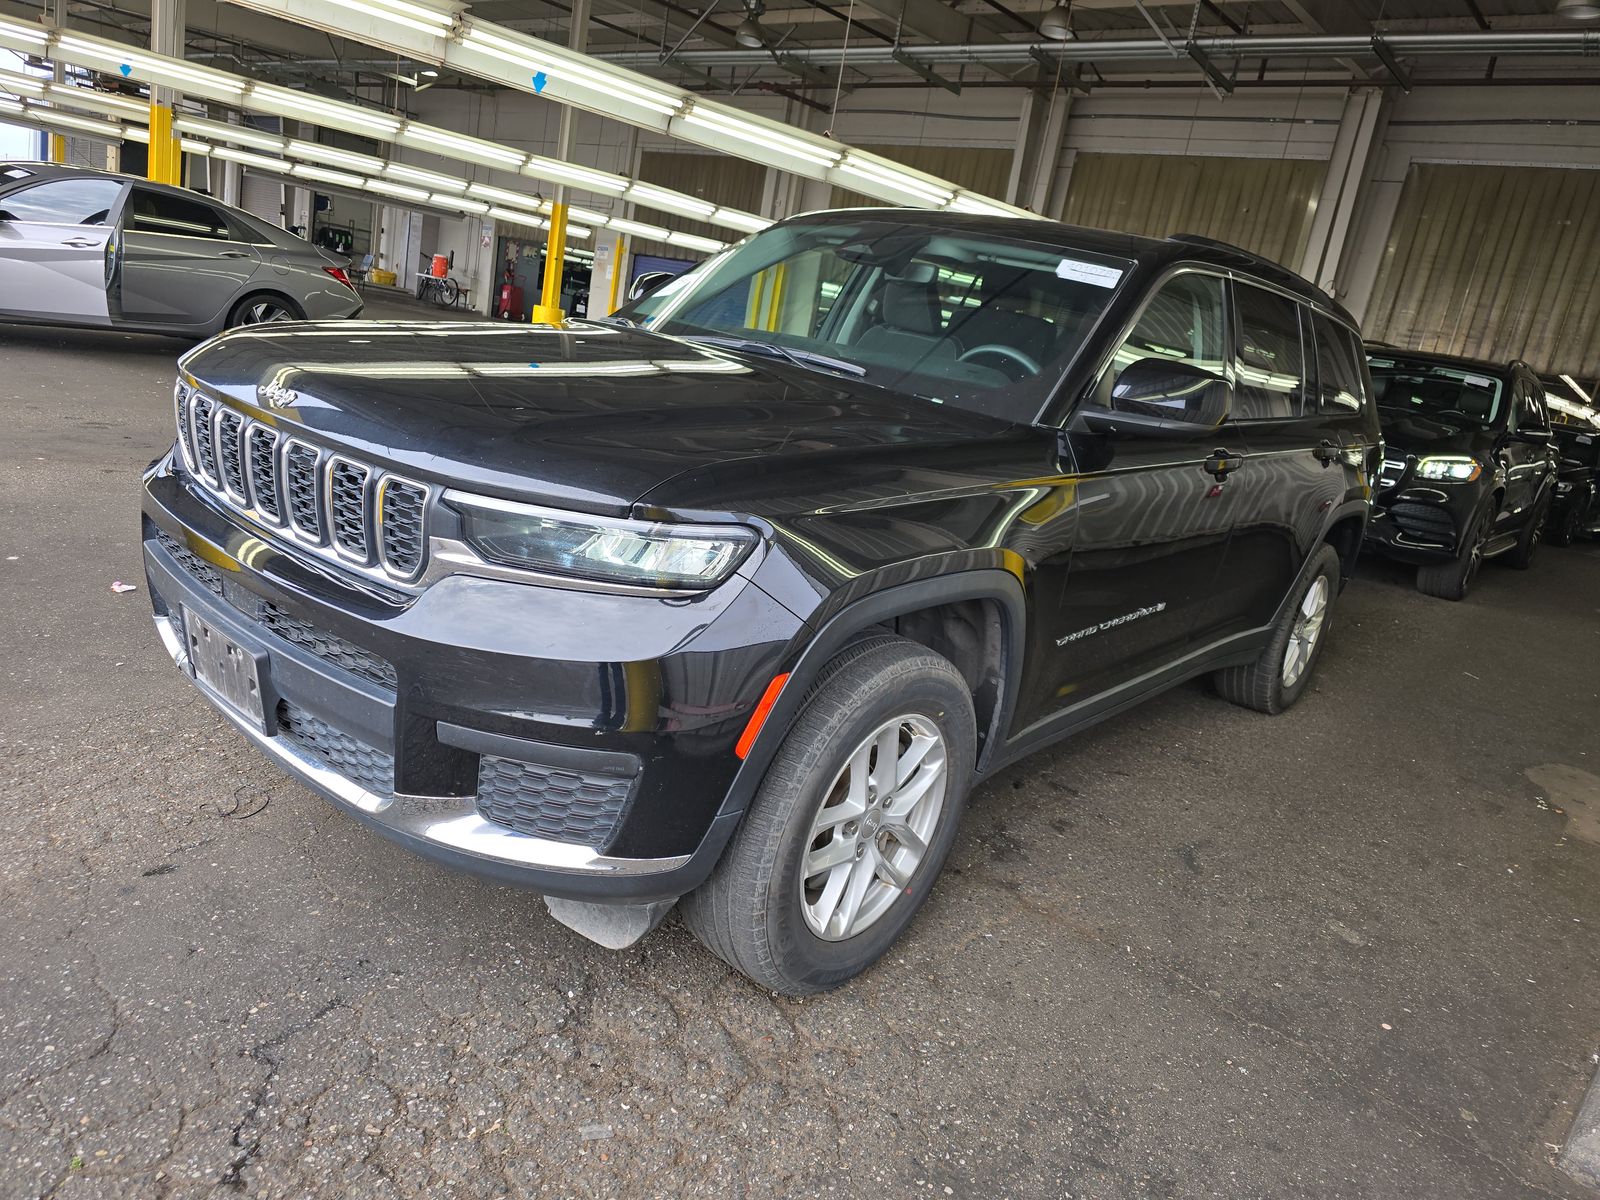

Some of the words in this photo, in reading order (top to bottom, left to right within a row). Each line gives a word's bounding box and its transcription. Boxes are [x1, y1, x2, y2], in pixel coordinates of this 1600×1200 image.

[258, 381, 298, 408] Jeep
[1056, 625, 1098, 646] GRAND
[1099, 602, 1166, 630] CHEROKEE
